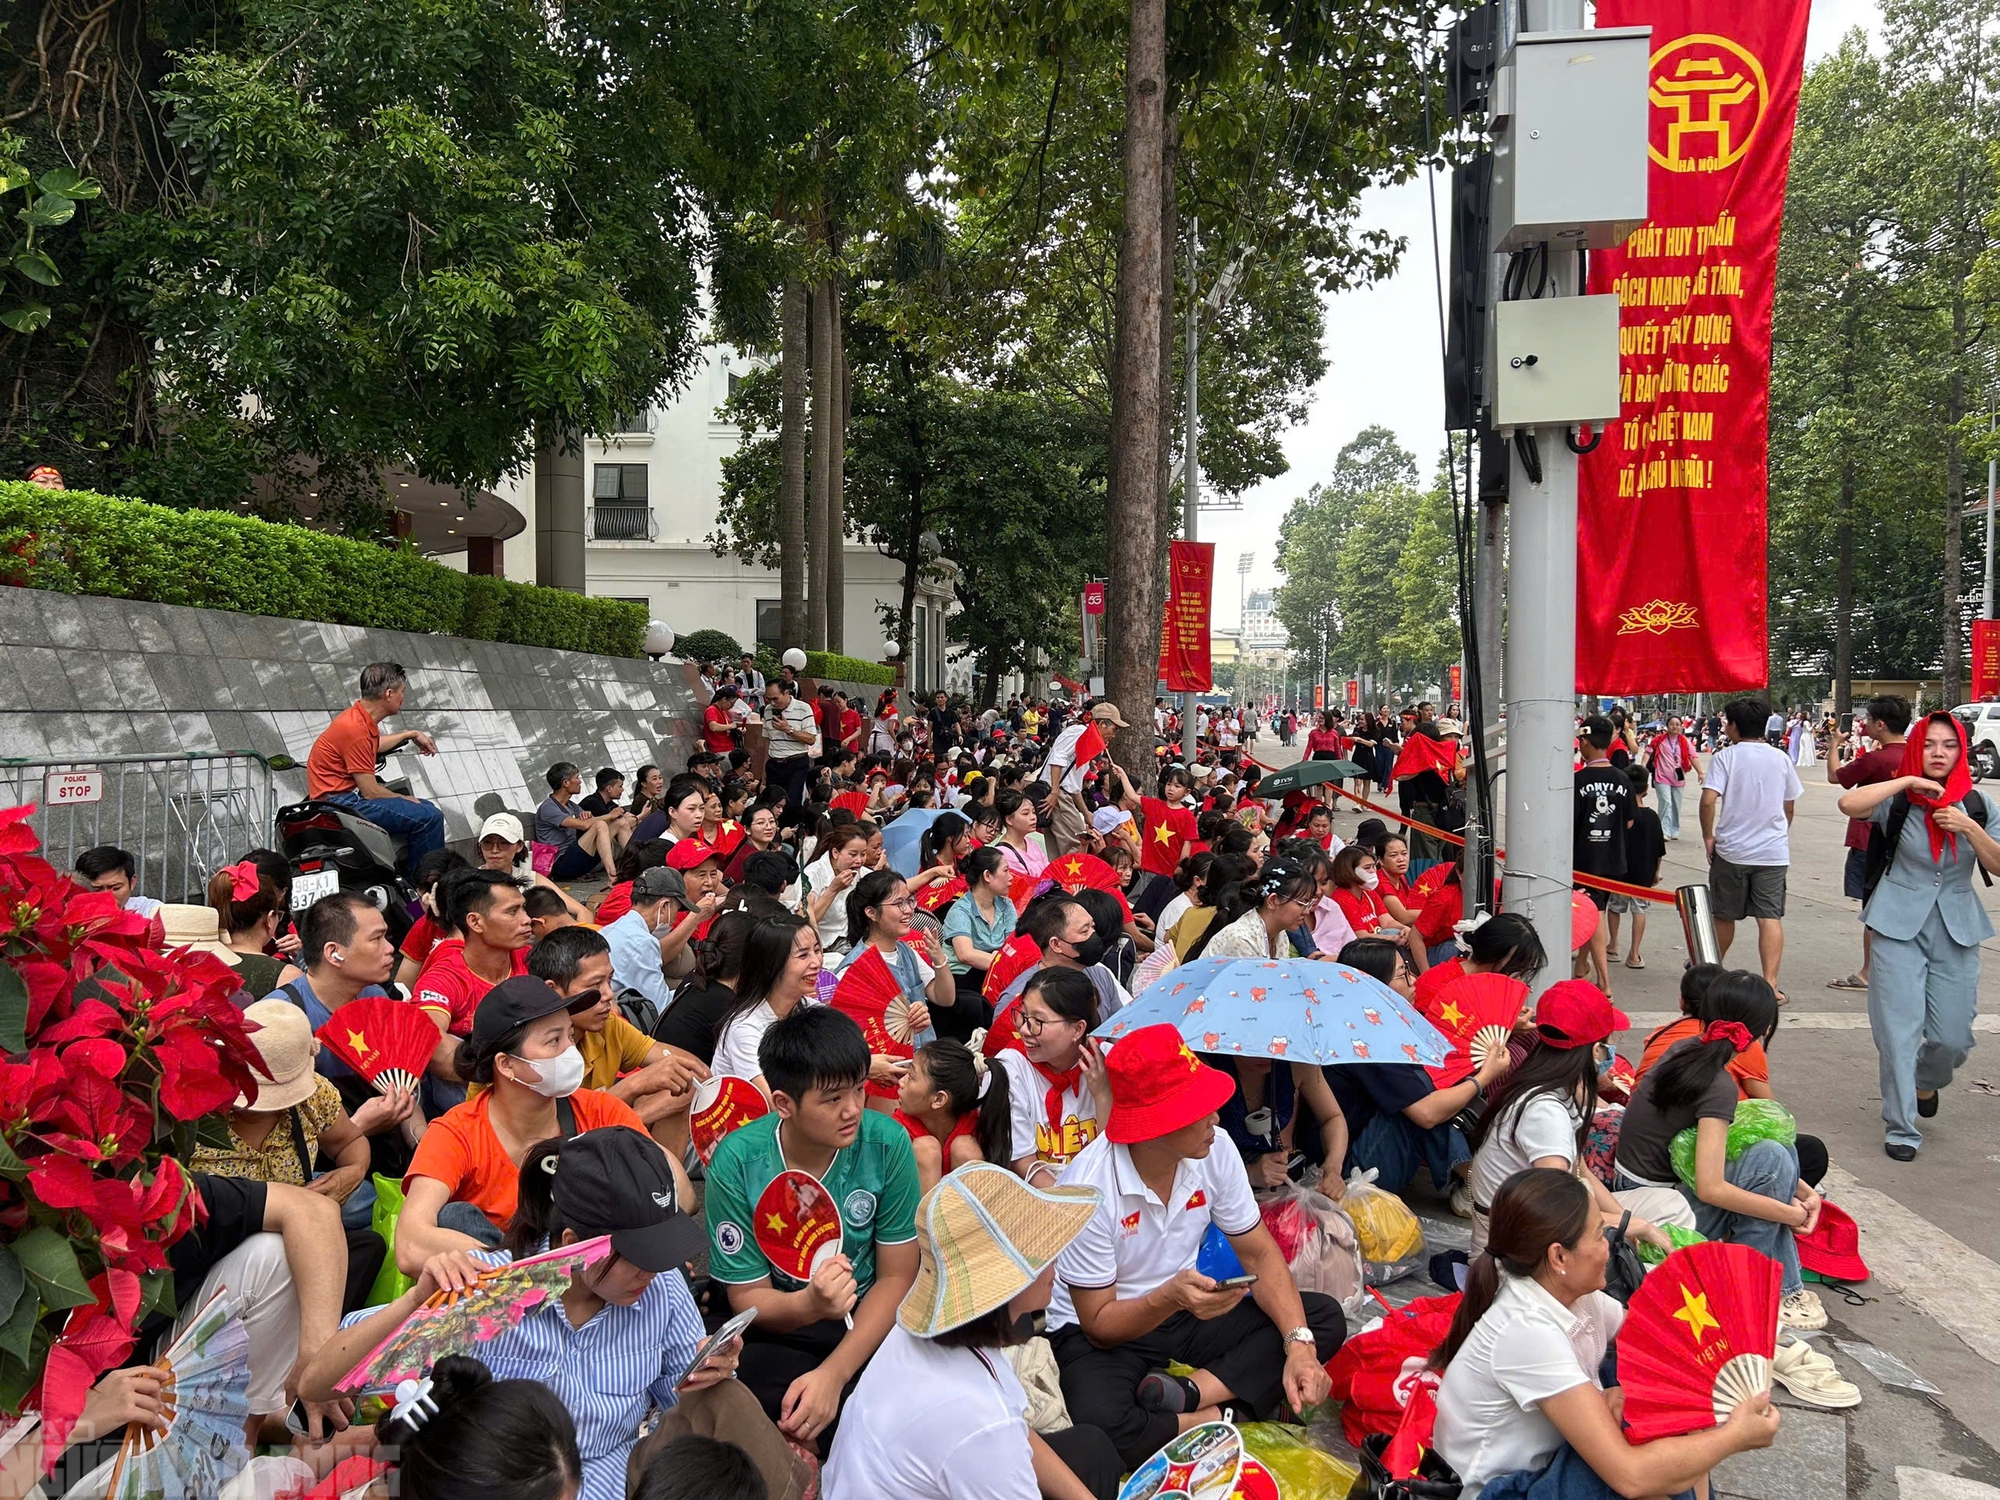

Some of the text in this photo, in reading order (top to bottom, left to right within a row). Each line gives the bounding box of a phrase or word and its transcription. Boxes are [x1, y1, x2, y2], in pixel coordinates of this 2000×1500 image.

[1678, 157, 1696, 172] HÀ
[1627, 222, 1663, 258] PHÁT
[1665, 227, 1693, 257] HUY
[1649, 275, 1692, 312] MẠNG
[1710, 259, 1744, 298] TÁM,
[1620, 319, 1659, 357] QUYẾT
[1693, 313, 1732, 351] DỰNG
[1692, 354, 1730, 393] CHẮC
[1623, 414, 1641, 450] TỔ
[1682, 412, 1714, 441] NAM
[1618, 463, 1635, 497] XÃ
[1088, 595, 1102, 605] 5G
[59, 785, 92, 798] STOP
[64, 775, 87, 783] POLICE
